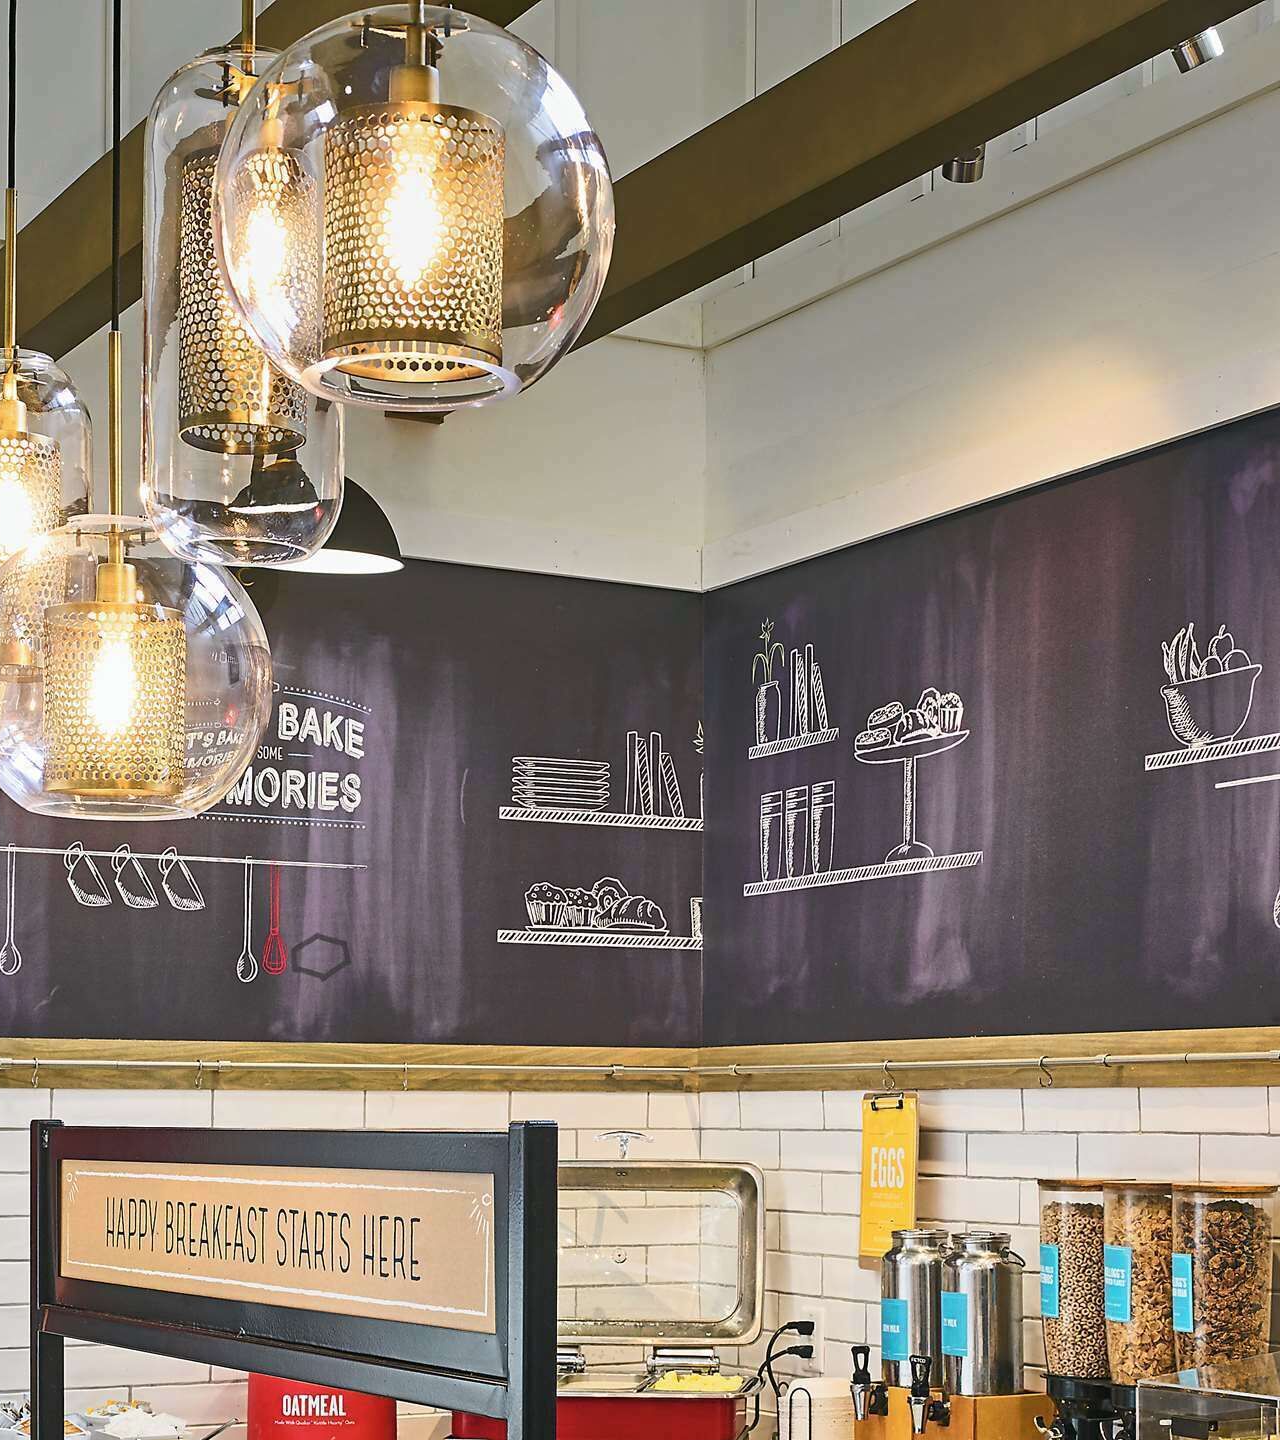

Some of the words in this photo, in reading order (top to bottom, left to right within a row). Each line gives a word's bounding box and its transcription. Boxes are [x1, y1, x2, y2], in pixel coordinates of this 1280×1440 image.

[278, 702, 365, 759] BAKE
[257, 746, 283, 760] SOME
[224, 766, 361, 813] MORIES
[870, 1147, 905, 1189] EGGS
[105, 1197, 159, 1252] HAPPY
[165, 1201, 268, 1265] BREAKFAST
[276, 1208, 351, 1274] STARTS
[362, 1215, 421, 1282] HERE
[282, 1394, 346, 1417] OATMEAL
